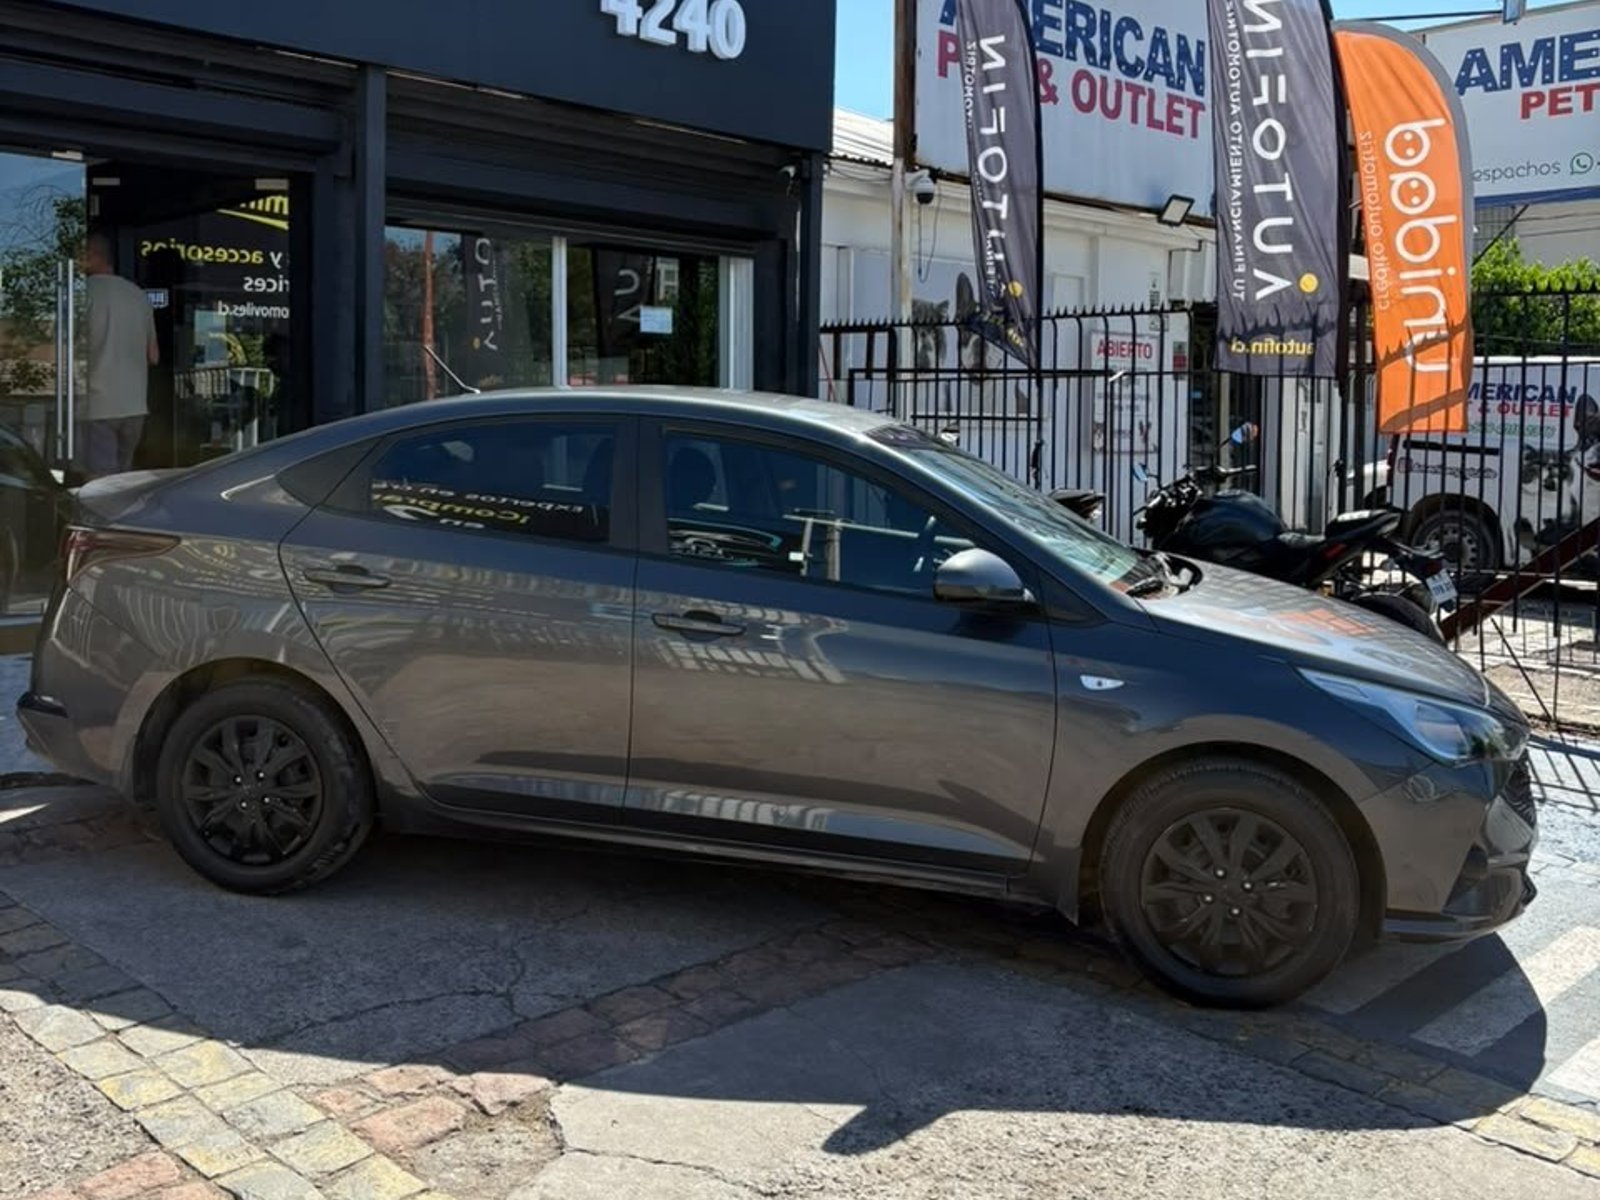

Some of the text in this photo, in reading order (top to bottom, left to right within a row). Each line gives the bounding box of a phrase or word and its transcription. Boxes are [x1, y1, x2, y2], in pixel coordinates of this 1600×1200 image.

[600, 0, 746, 60] 4240
[939, 0, 1206, 97] ERICAN
[1454, 29, 1600, 96] AME
[1071, 69, 1206, 139] OUTLET
[1520, 82, 1600, 120] PET
[1472, 160, 1562, 184] espachos
[1468, 383, 1577, 403] MERICAN
